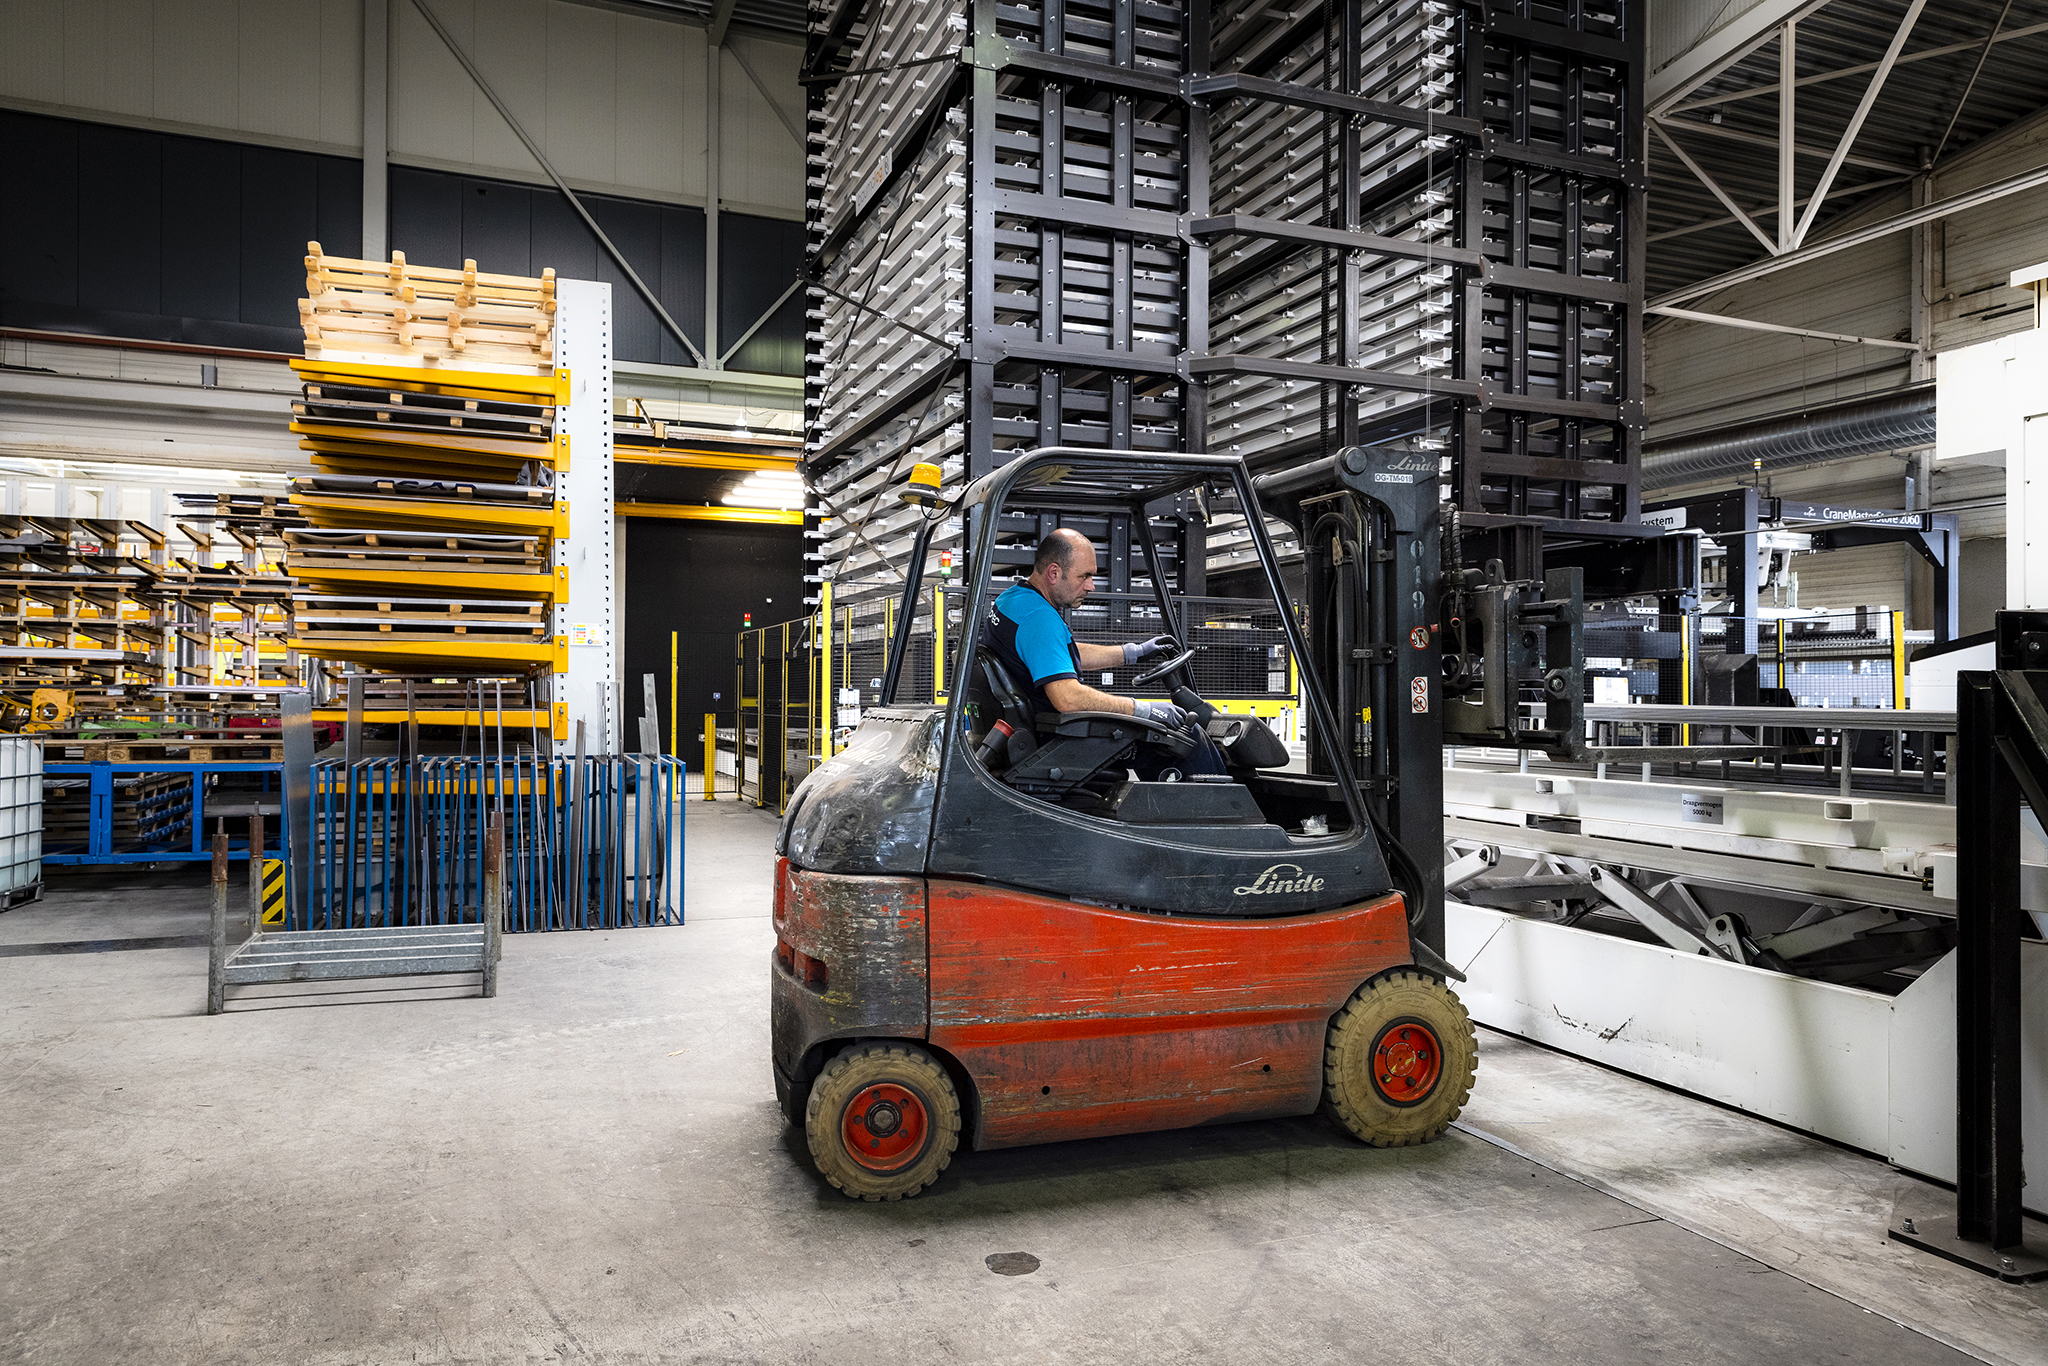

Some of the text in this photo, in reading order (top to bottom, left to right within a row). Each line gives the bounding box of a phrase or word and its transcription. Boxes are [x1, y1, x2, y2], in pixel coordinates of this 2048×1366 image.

[1386, 453, 1438, 471] Linde
[1899, 512, 1920, 525] 2060
[1682, 799, 1723, 809] Draagvermogen
[1233, 863, 1325, 896] Linde
